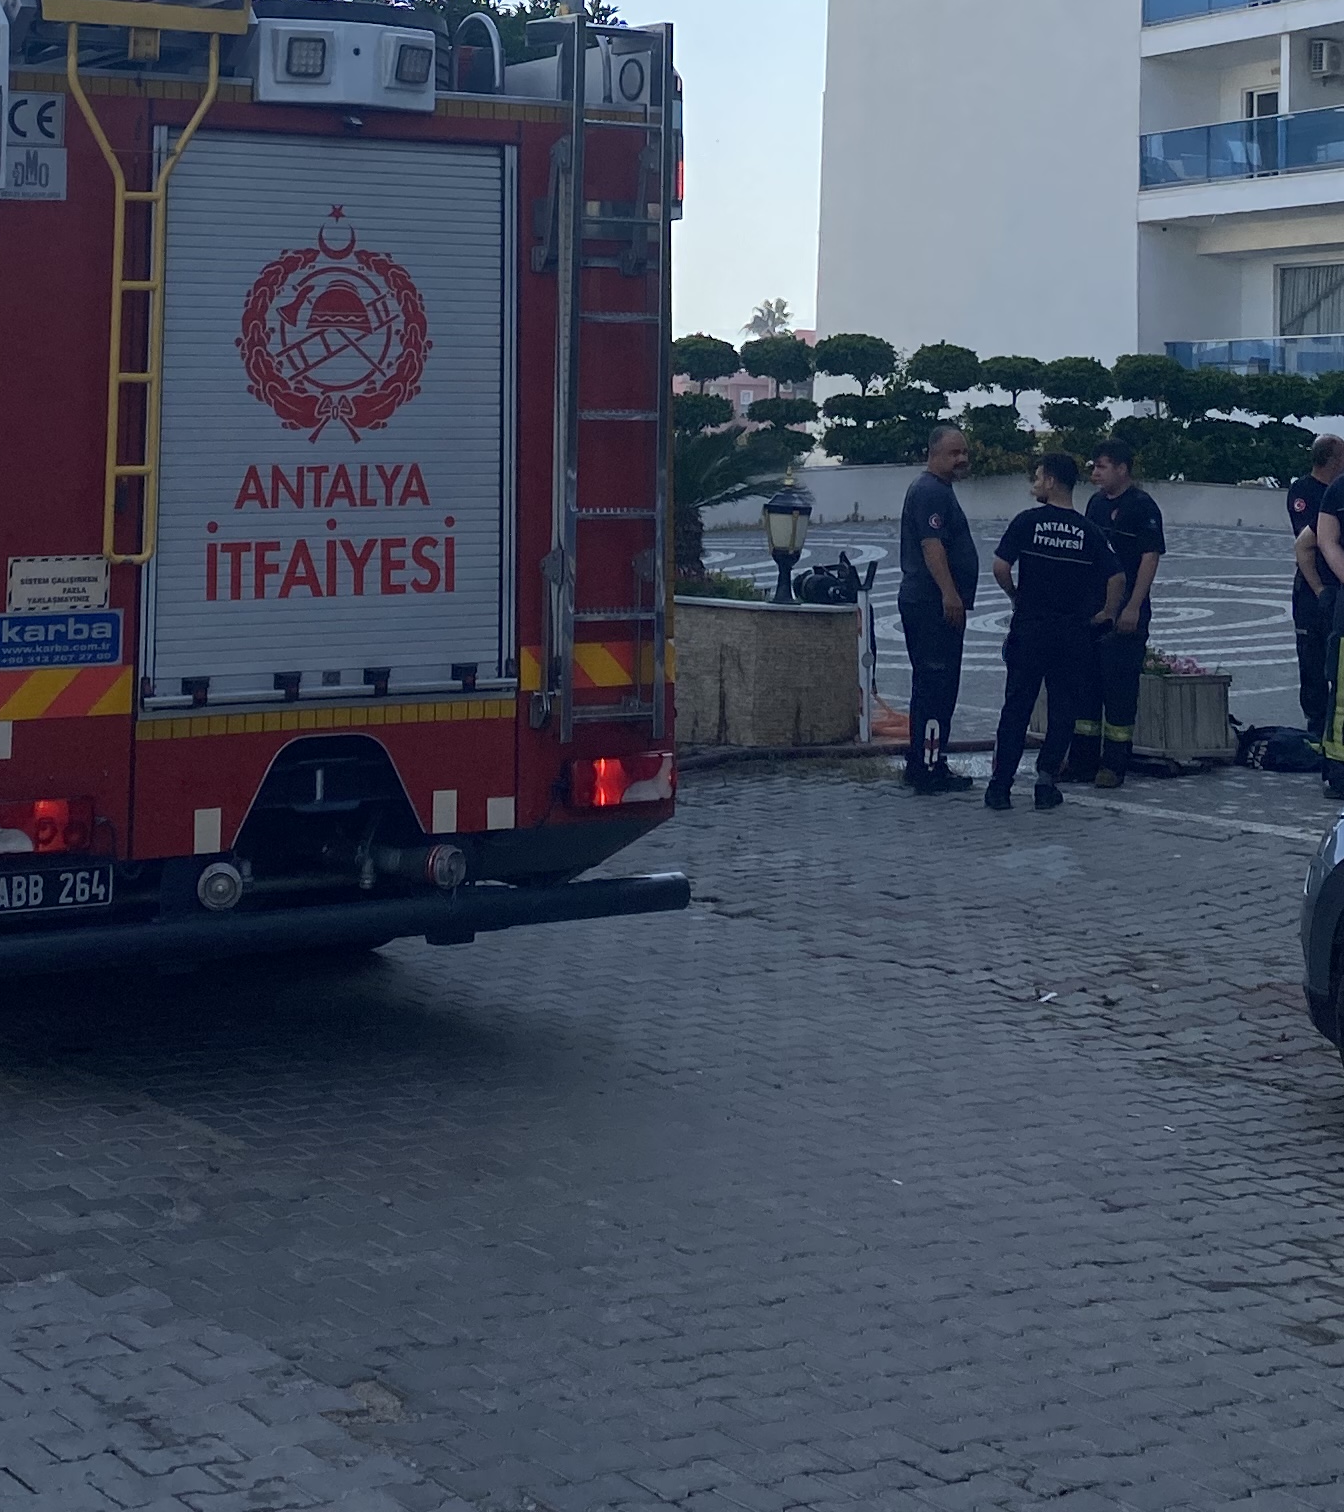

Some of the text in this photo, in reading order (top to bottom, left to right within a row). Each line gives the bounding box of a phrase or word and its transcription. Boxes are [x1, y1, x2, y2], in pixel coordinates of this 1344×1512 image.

[234, 462, 431, 510] ANTALYA
[1035, 522, 1085, 539] ANTALYA
[206, 515, 456, 601] İTFAİYESİ
[20, 576, 49, 585] SİSTEM
[1, 617, 112, 643] karba
[1, 642, 111, 655] www.karba.com.tr
[58, 870, 106, 904] 264
